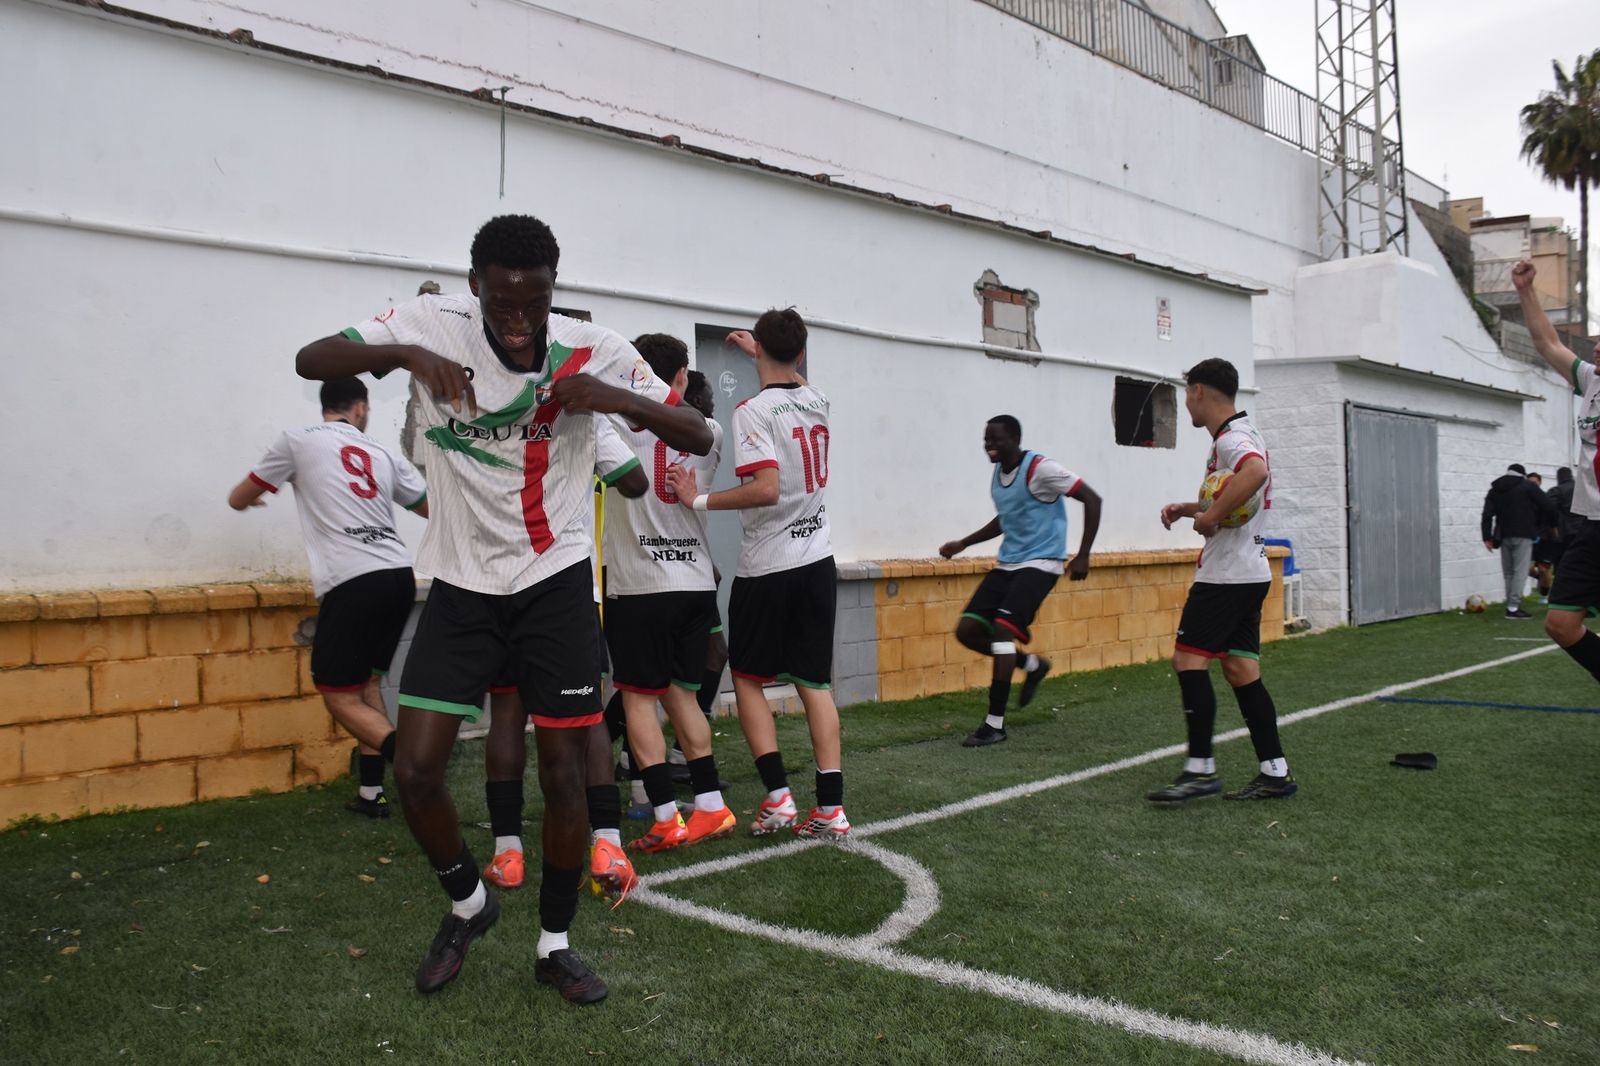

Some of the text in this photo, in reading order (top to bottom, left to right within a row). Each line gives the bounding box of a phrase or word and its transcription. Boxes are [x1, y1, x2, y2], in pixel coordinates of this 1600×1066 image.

[448, 417, 553, 441] CEUTA
[340, 445, 378, 500] 9
[792, 424, 830, 495] 10
